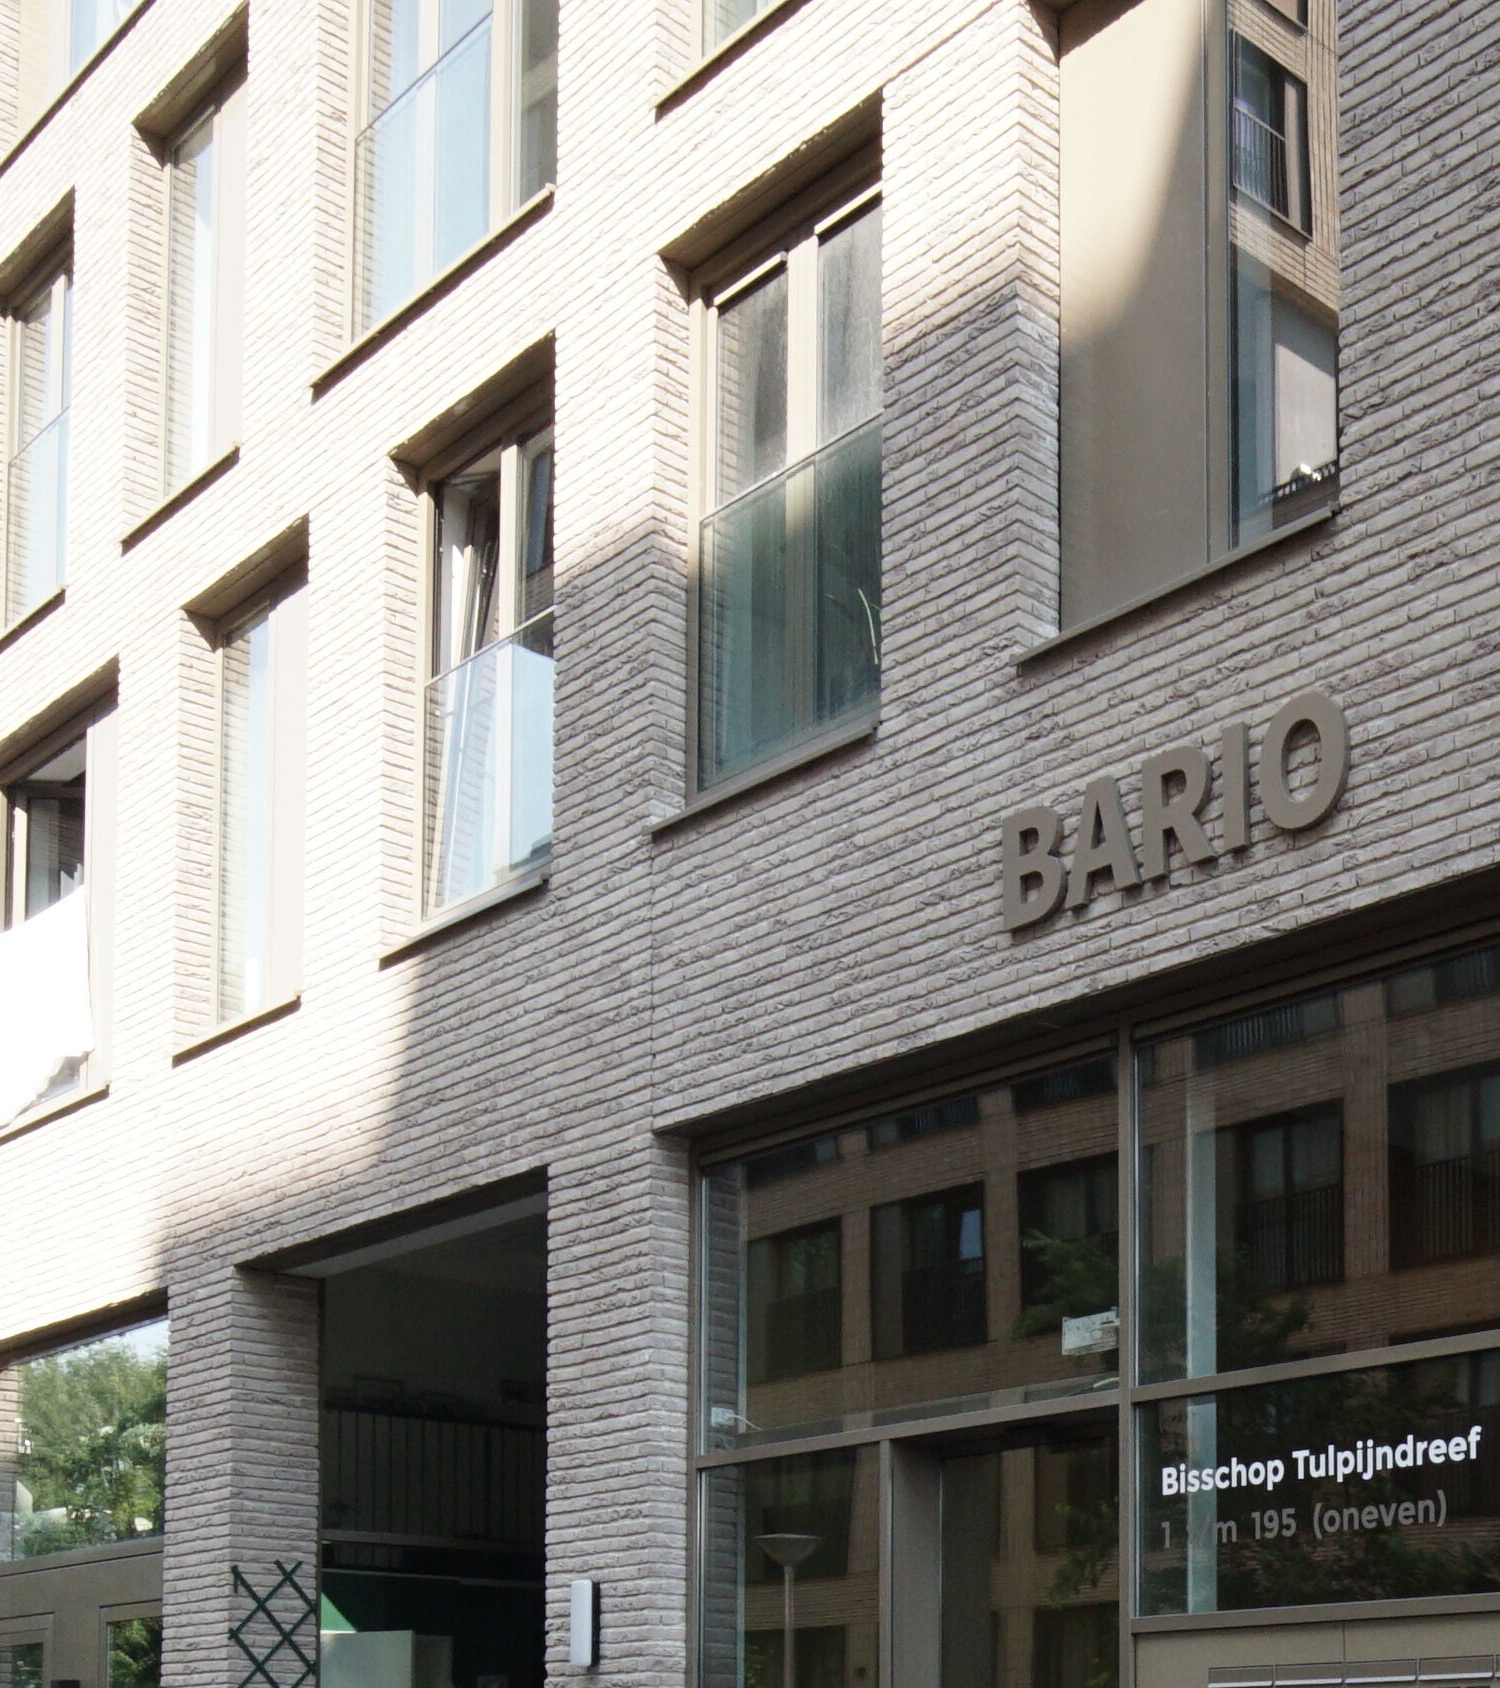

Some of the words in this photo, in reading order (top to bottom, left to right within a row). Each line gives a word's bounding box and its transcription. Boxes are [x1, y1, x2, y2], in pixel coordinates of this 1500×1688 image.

[1003, 693, 1351, 931] BARIO
[1161, 1454, 1285, 1496] Bisschop
[1292, 1425, 1483, 1483] Tulpijndreef
[1161, 1520, 1172, 1549] 1
[1251, 1507, 1297, 1541] 195
[1313, 1489, 1448, 1540] (oneven)
